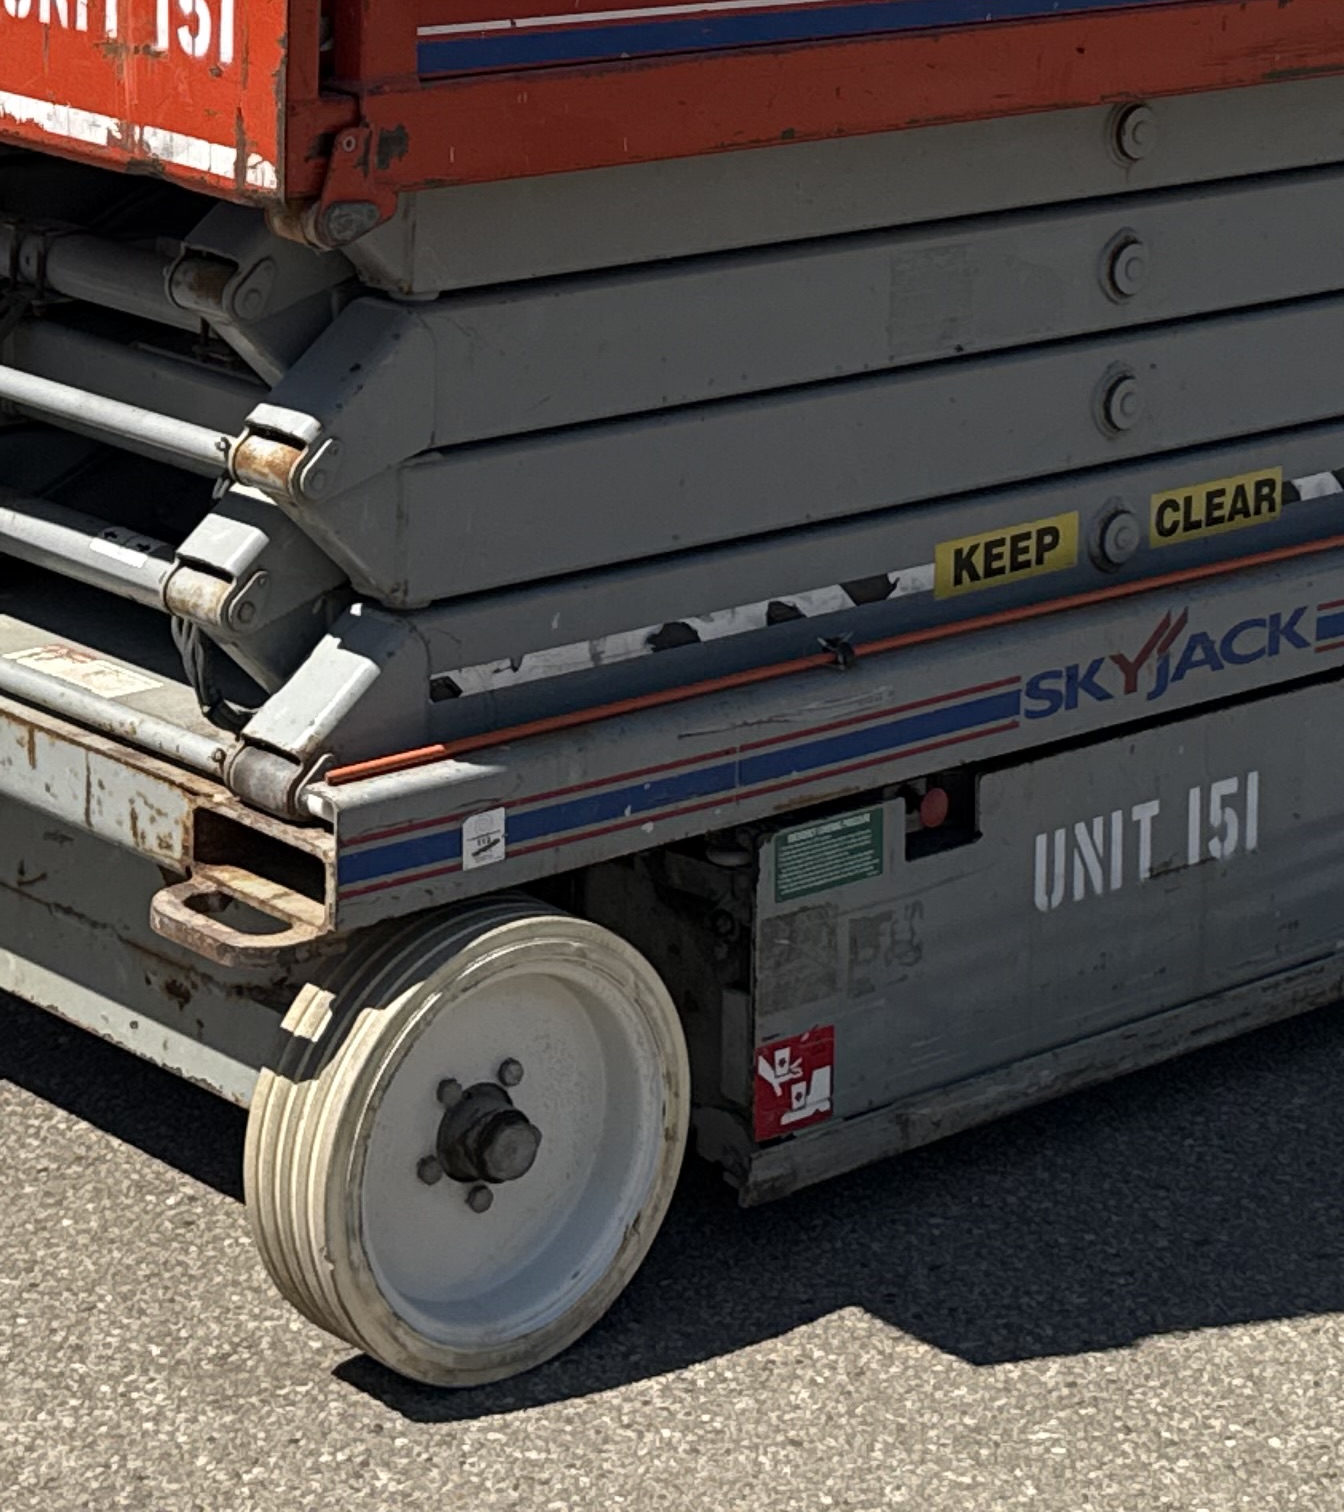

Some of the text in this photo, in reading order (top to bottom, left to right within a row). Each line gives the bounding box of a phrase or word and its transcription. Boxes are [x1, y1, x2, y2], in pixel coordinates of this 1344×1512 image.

[952, 477, 1277, 588] KEEP CLEAR
[1023, 606, 1311, 720] SKYJACK
[1034, 770, 1259, 913] UNIT 151
